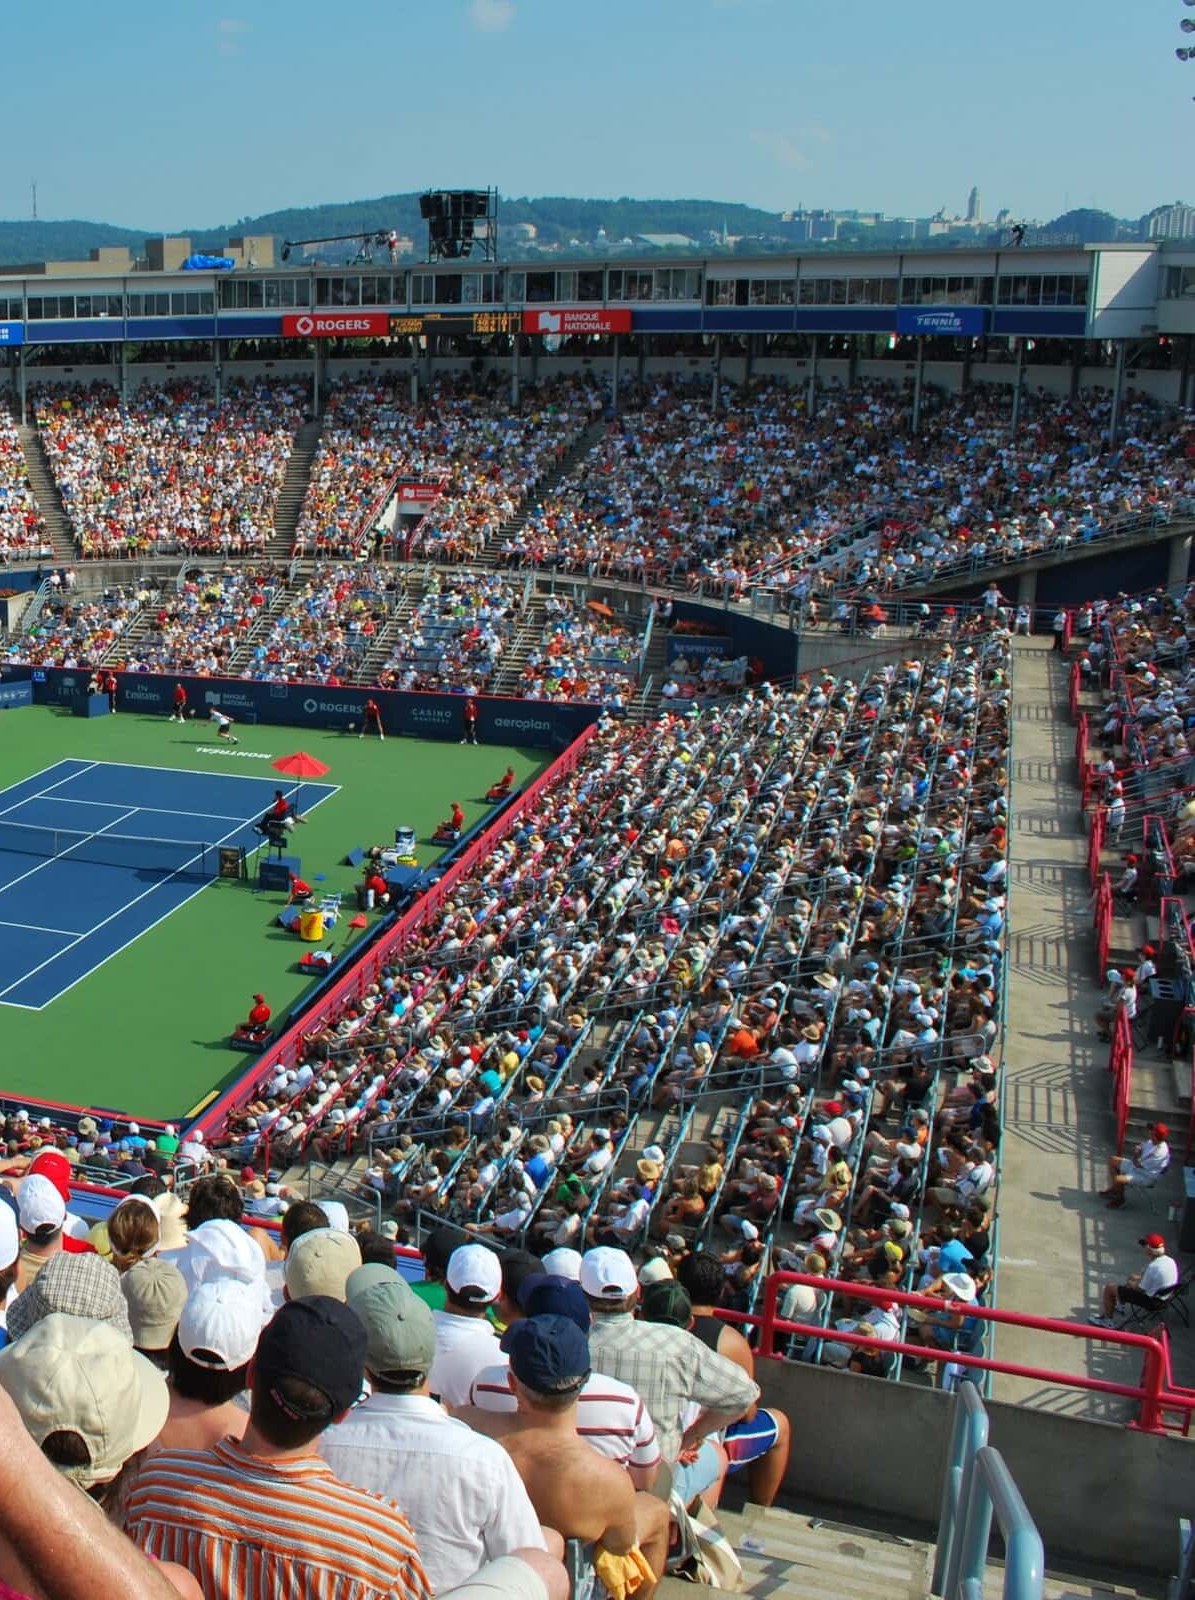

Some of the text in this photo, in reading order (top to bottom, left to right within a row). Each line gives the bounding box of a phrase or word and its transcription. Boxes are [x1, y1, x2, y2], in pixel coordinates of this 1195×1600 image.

[564, 312, 599, 321] BANQUE
[316, 319, 371, 331] ROGERS
[564, 321, 611, 330] NATIONALE
[916, 317, 963, 327] TENNIS
[57, 687, 81, 697] IRIS
[318, 703, 363, 714] ROGERS
[411, 707, 452, 718] CASINO
[494, 717, 551, 732] aeroplan
